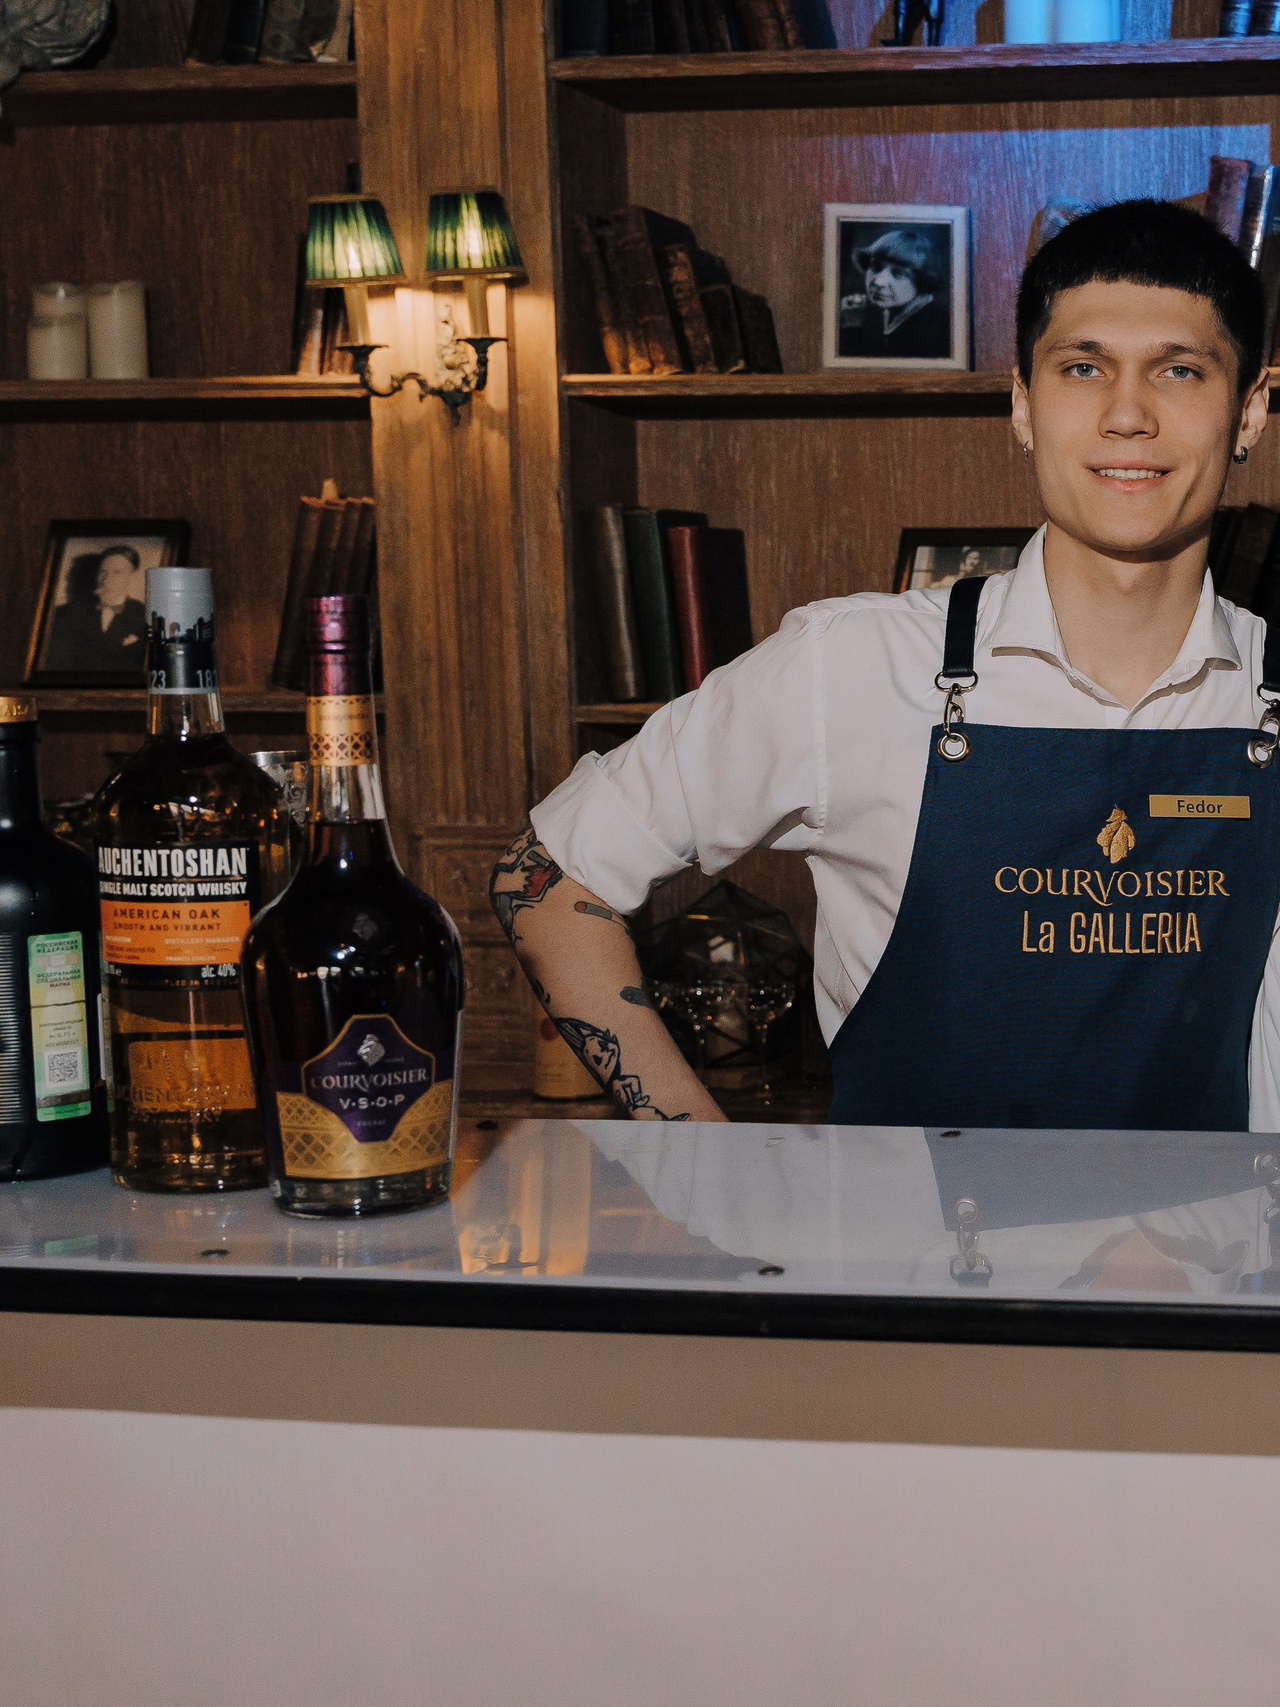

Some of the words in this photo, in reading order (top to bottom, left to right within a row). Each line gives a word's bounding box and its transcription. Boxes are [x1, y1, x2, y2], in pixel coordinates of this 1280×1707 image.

[1176, 800, 1224, 815] Fedor
[98, 846, 248, 877] AUCHENTOSHAN
[122, 883, 149, 896] MALT
[150, 883, 195, 897] SCOTCH
[197, 881, 248, 896] WHISKY
[994, 866, 1231, 907] COURVOISIER
[113, 908, 181, 920] AMERICAN
[189, 909, 221, 920] OAK
[149, 923, 169, 931] AND
[174, 922, 221, 931] VIBRANT
[1021, 910, 1056, 953] La
[1069, 911, 1202, 954] GALLERIA
[217, 962, 237, 977] 40%
[310, 1068, 428, 1093] COURVOISIER
